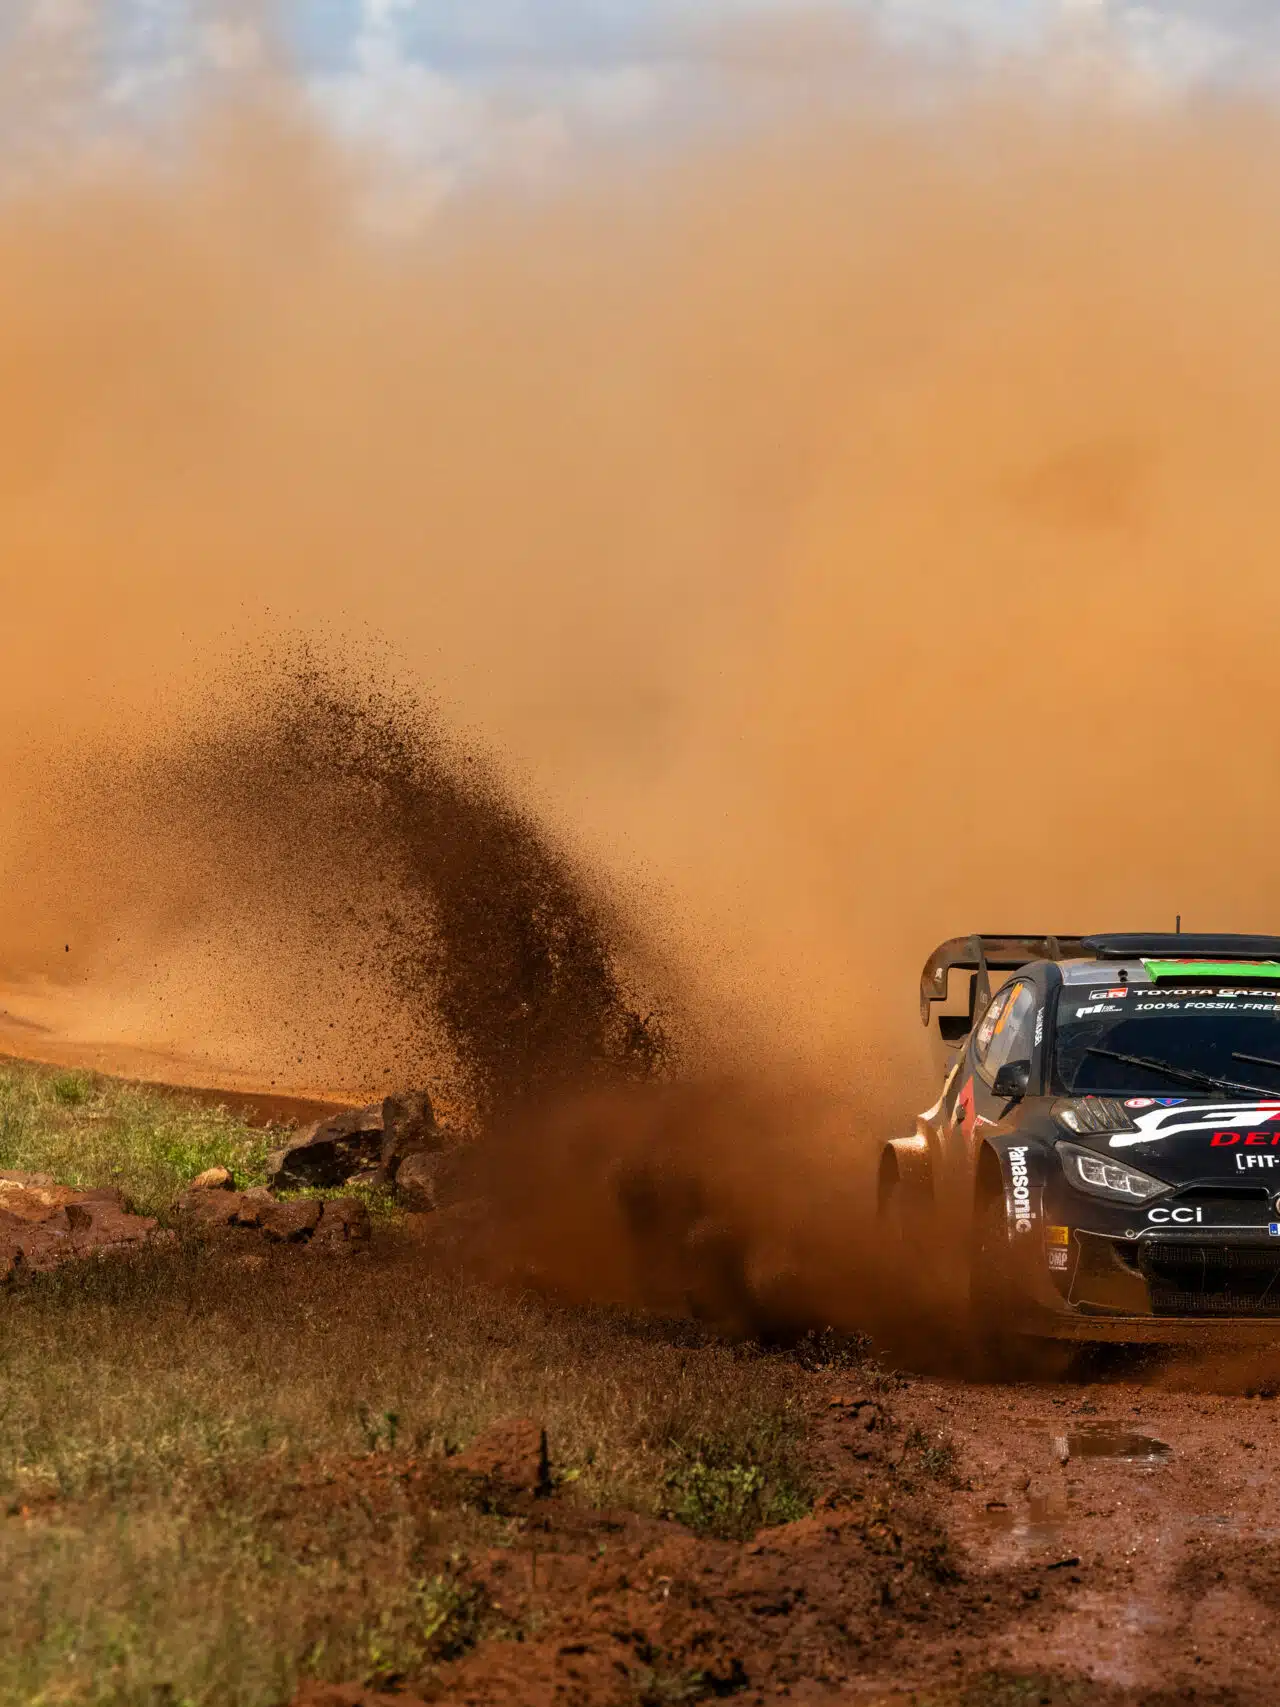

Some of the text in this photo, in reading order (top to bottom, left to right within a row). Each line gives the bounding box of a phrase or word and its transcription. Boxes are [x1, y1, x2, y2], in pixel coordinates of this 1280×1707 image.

[1090, 988, 1128, 1000] GR
[1134, 1002, 1181, 1011] 100%
[1007, 1146, 1036, 1233] Panasonic
